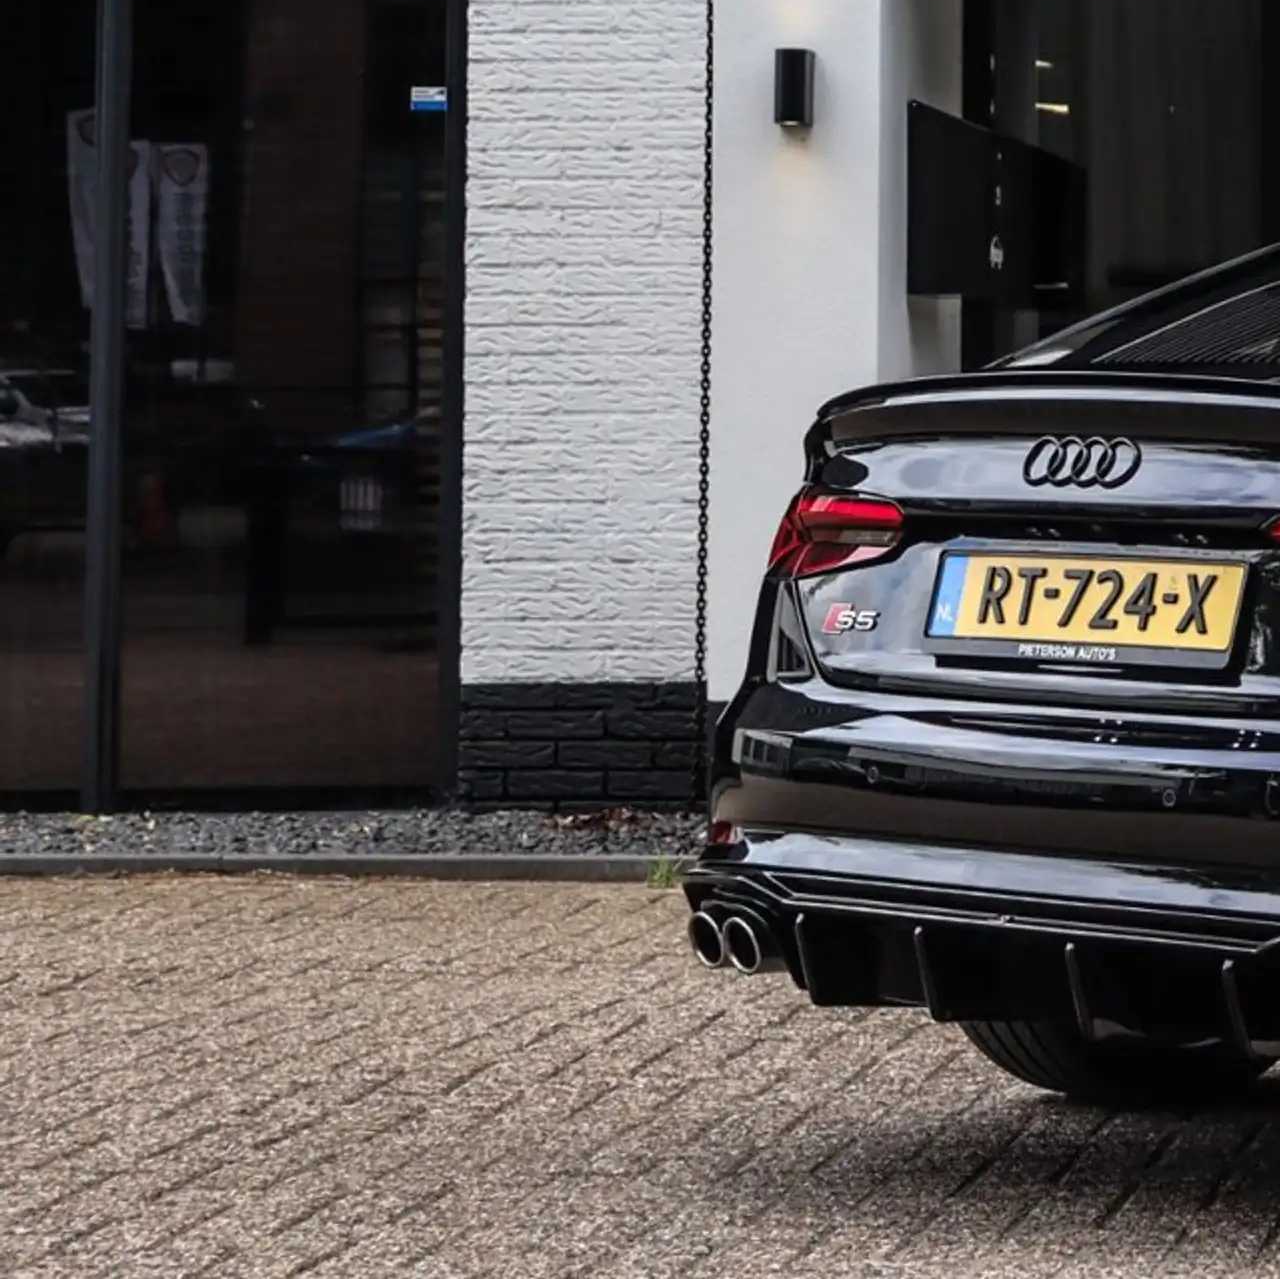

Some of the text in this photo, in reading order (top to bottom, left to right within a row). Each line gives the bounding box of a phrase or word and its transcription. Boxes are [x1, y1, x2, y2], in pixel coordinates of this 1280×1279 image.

[977, 565, 1218, 635] RT-724-X
[834, 610, 879, 631] S5
[1018, 643, 1117, 660] PIETERSON AUTO'S
